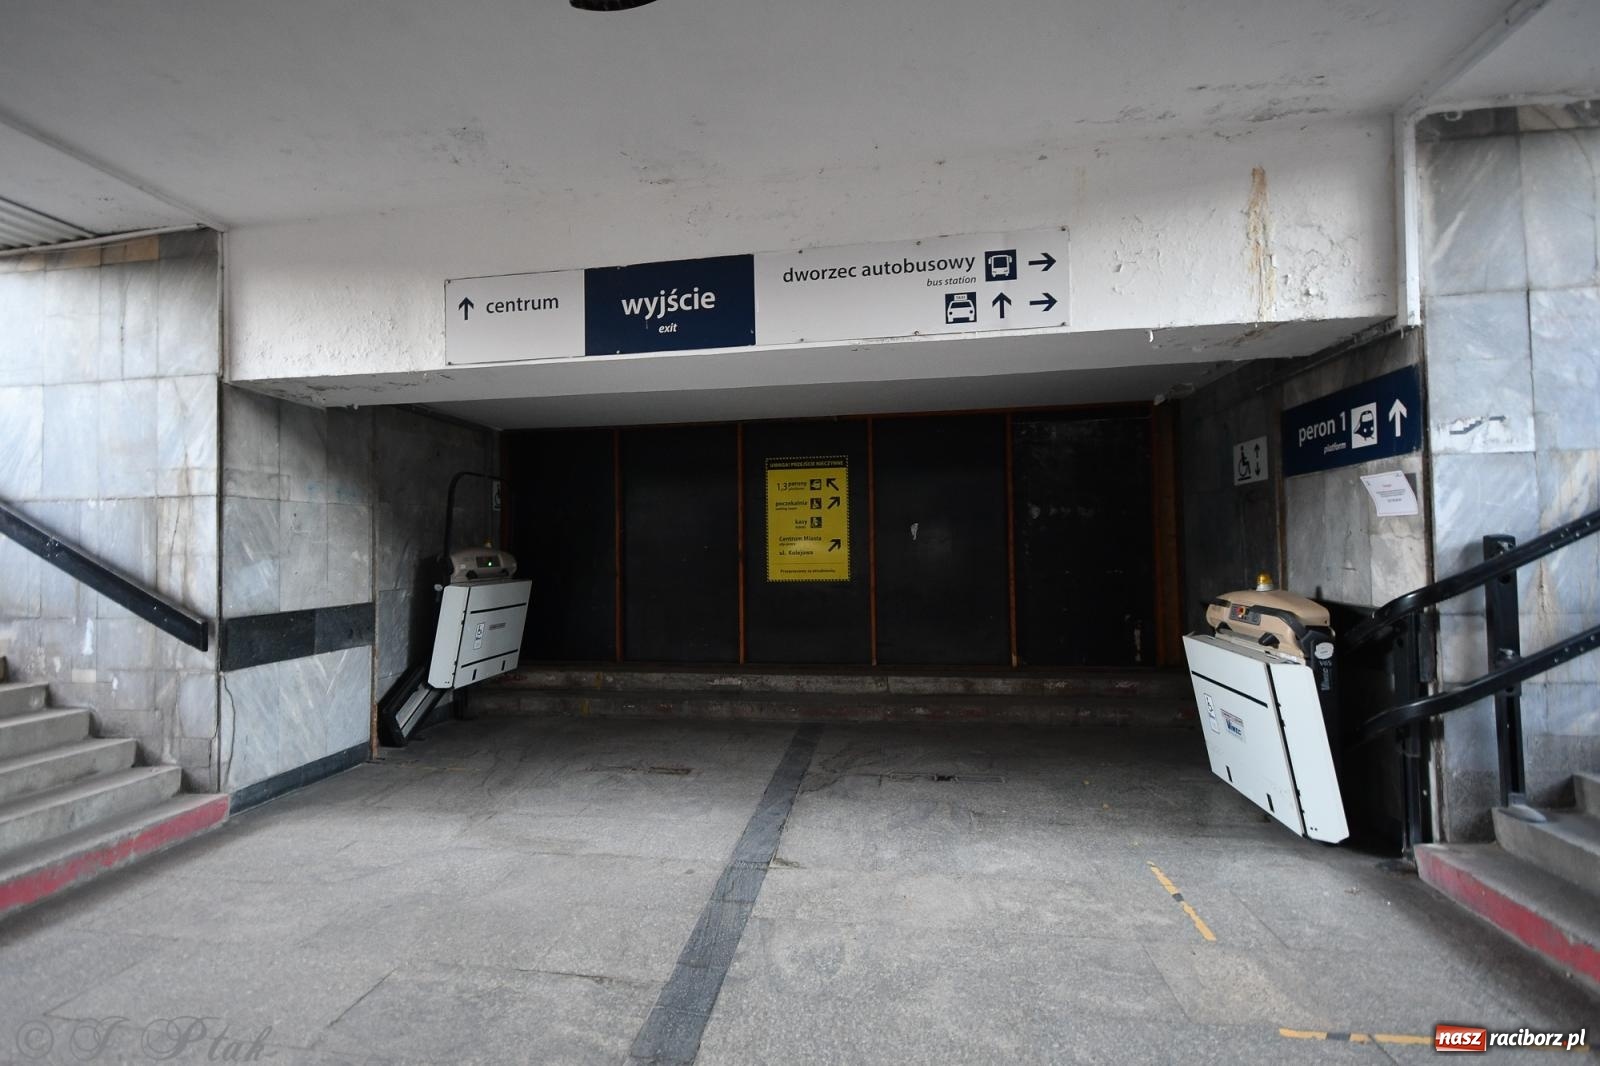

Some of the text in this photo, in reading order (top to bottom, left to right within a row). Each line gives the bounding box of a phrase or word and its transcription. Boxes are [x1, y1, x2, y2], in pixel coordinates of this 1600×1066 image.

[783, 255, 976, 283] dworzec autobusowy
[926, 275, 977, 287] bus station
[486, 295, 559, 314] centrum
[621, 286, 716, 320] wyjście
[658, 322, 678, 334] exit
[1298, 411, 1347, 448] peron 1
